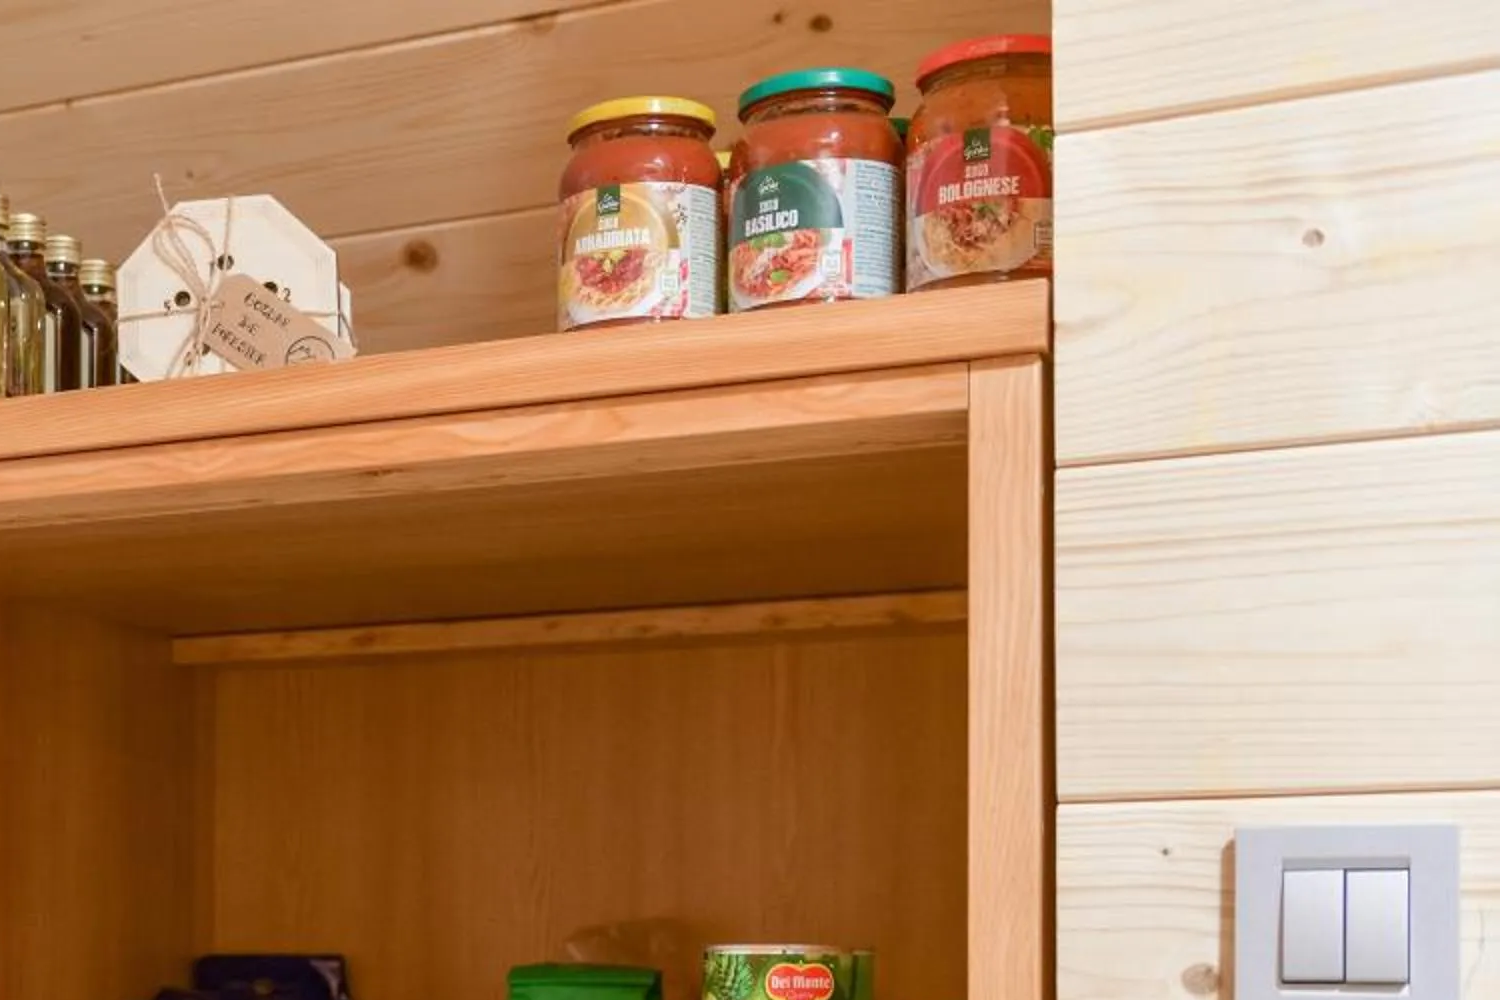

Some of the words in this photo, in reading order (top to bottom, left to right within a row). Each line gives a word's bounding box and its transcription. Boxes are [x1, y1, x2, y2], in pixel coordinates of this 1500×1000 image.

[938, 175, 1021, 205] BOLOGNESE
[744, 208, 800, 238] BASILICO
[771, 975, 791, 989] Del
